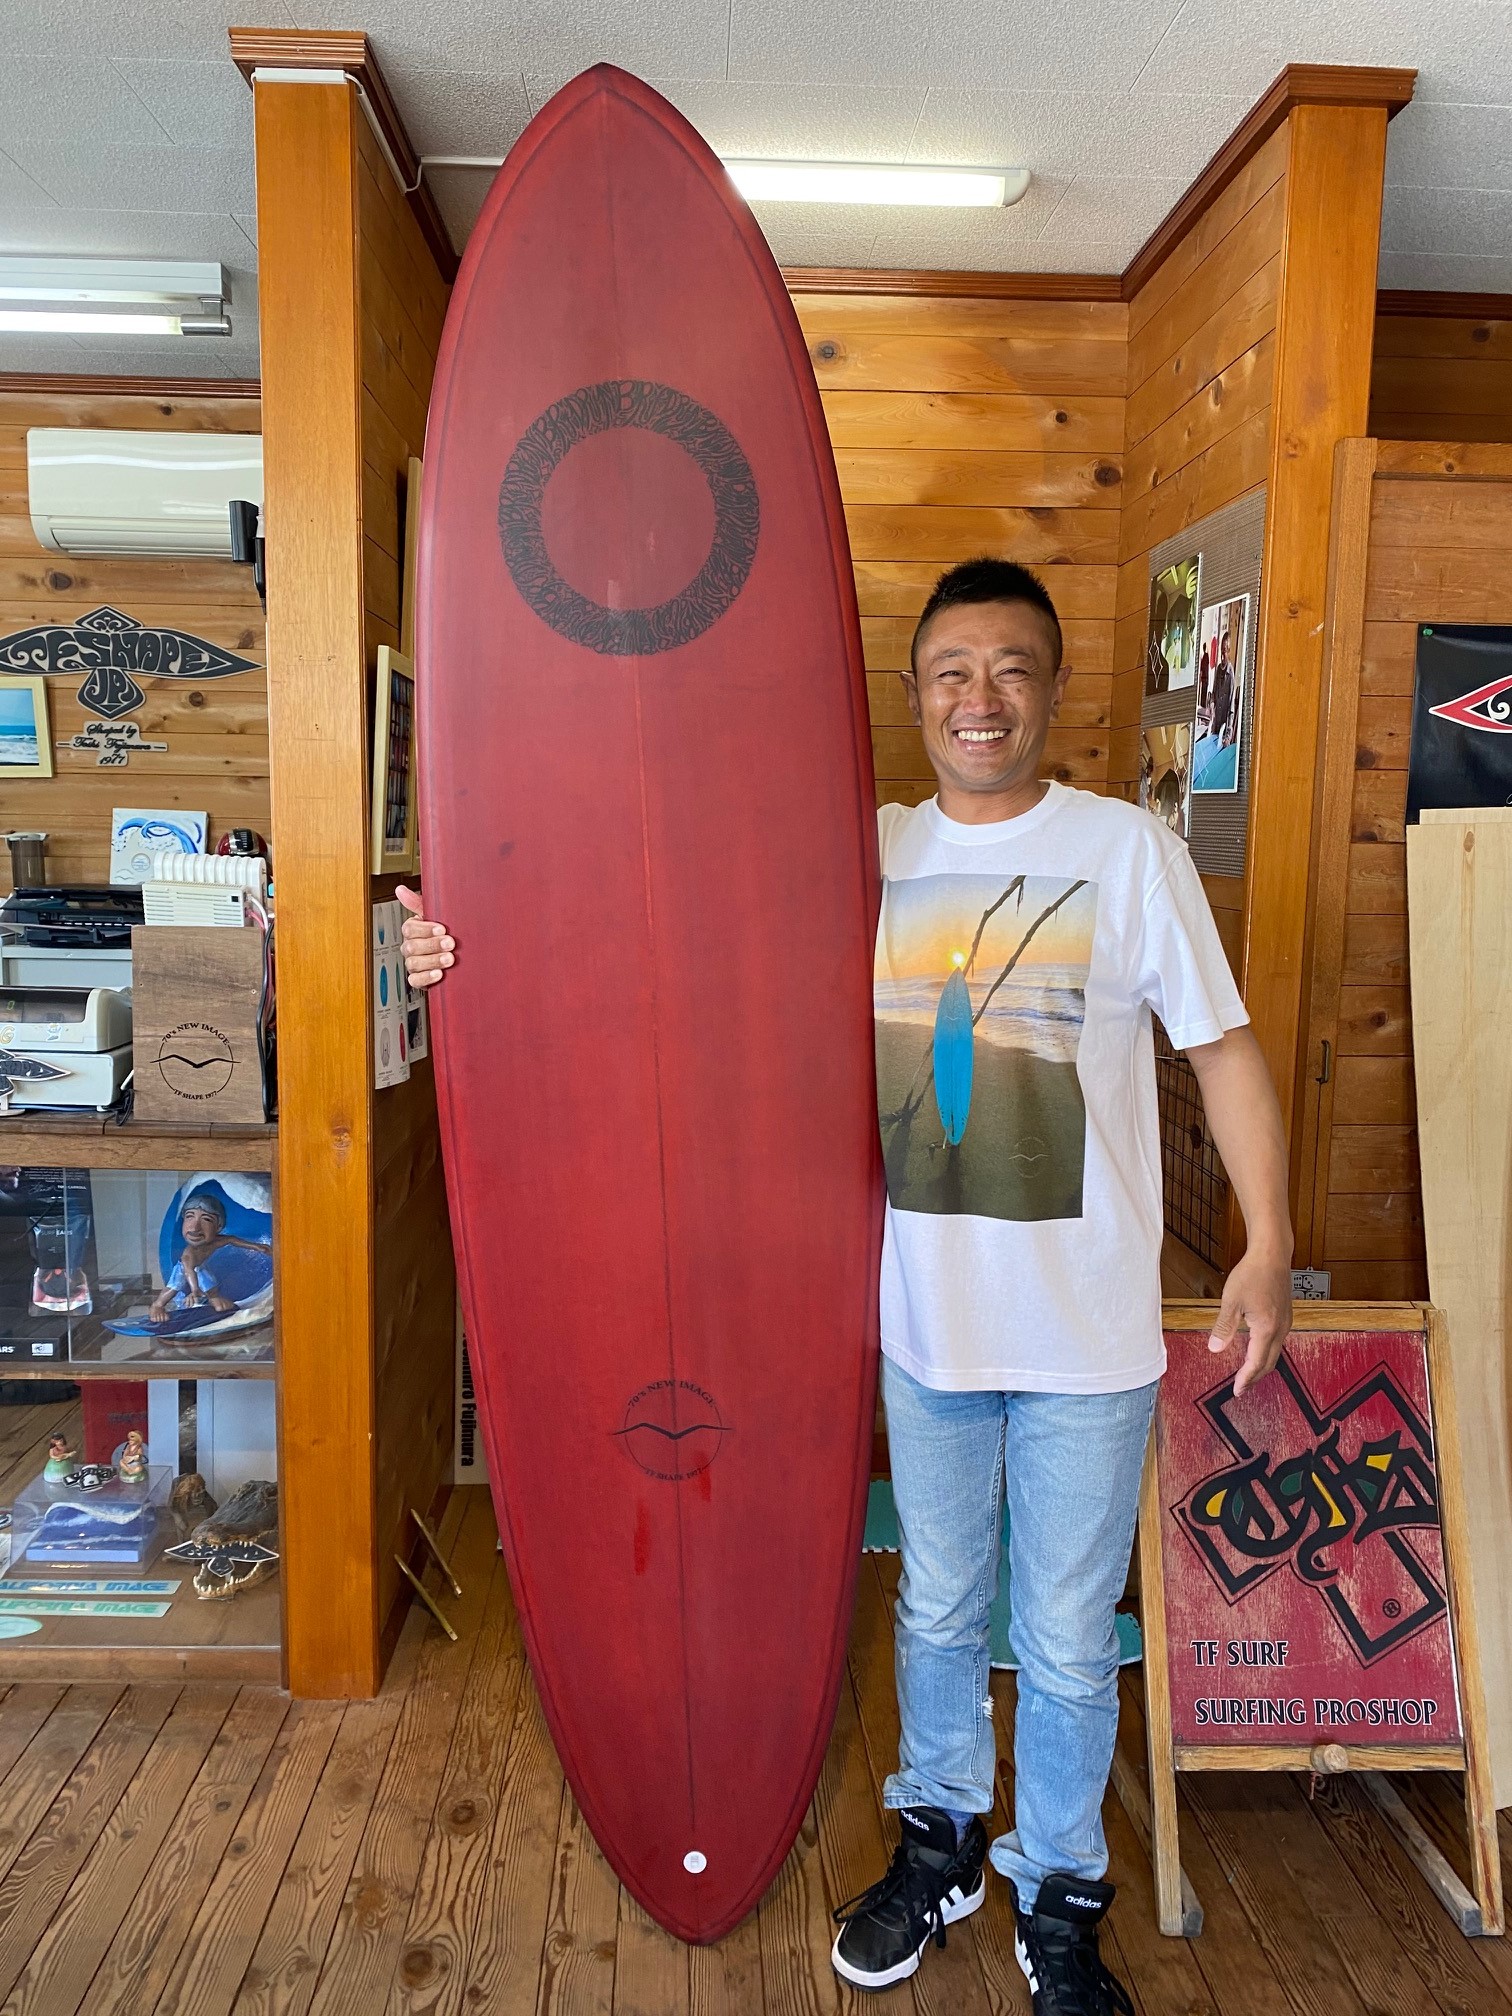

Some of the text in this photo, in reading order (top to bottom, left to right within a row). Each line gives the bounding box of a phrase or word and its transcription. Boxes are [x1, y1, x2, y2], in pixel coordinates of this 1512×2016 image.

[86, 723, 137, 739] Shaped by
[99, 753, 126, 765] 1977
[162, 1022, 230, 1046] 70's NEW IMAGE
[182, 1092, 204, 1100] SHAPE
[628, 1380, 716, 1408] 70's NEW IMAGE
[460, 1402, 477, 1467] Fujimura
[103, 1582, 170, 1591] IMAGE
[1190, 1640, 1289, 1667] TF SURF
[1194, 1697, 1438, 1726] SURFING PROSHOP
[900, 1809, 930, 1831] adidas
[1065, 1894, 1102, 1909] adidas
